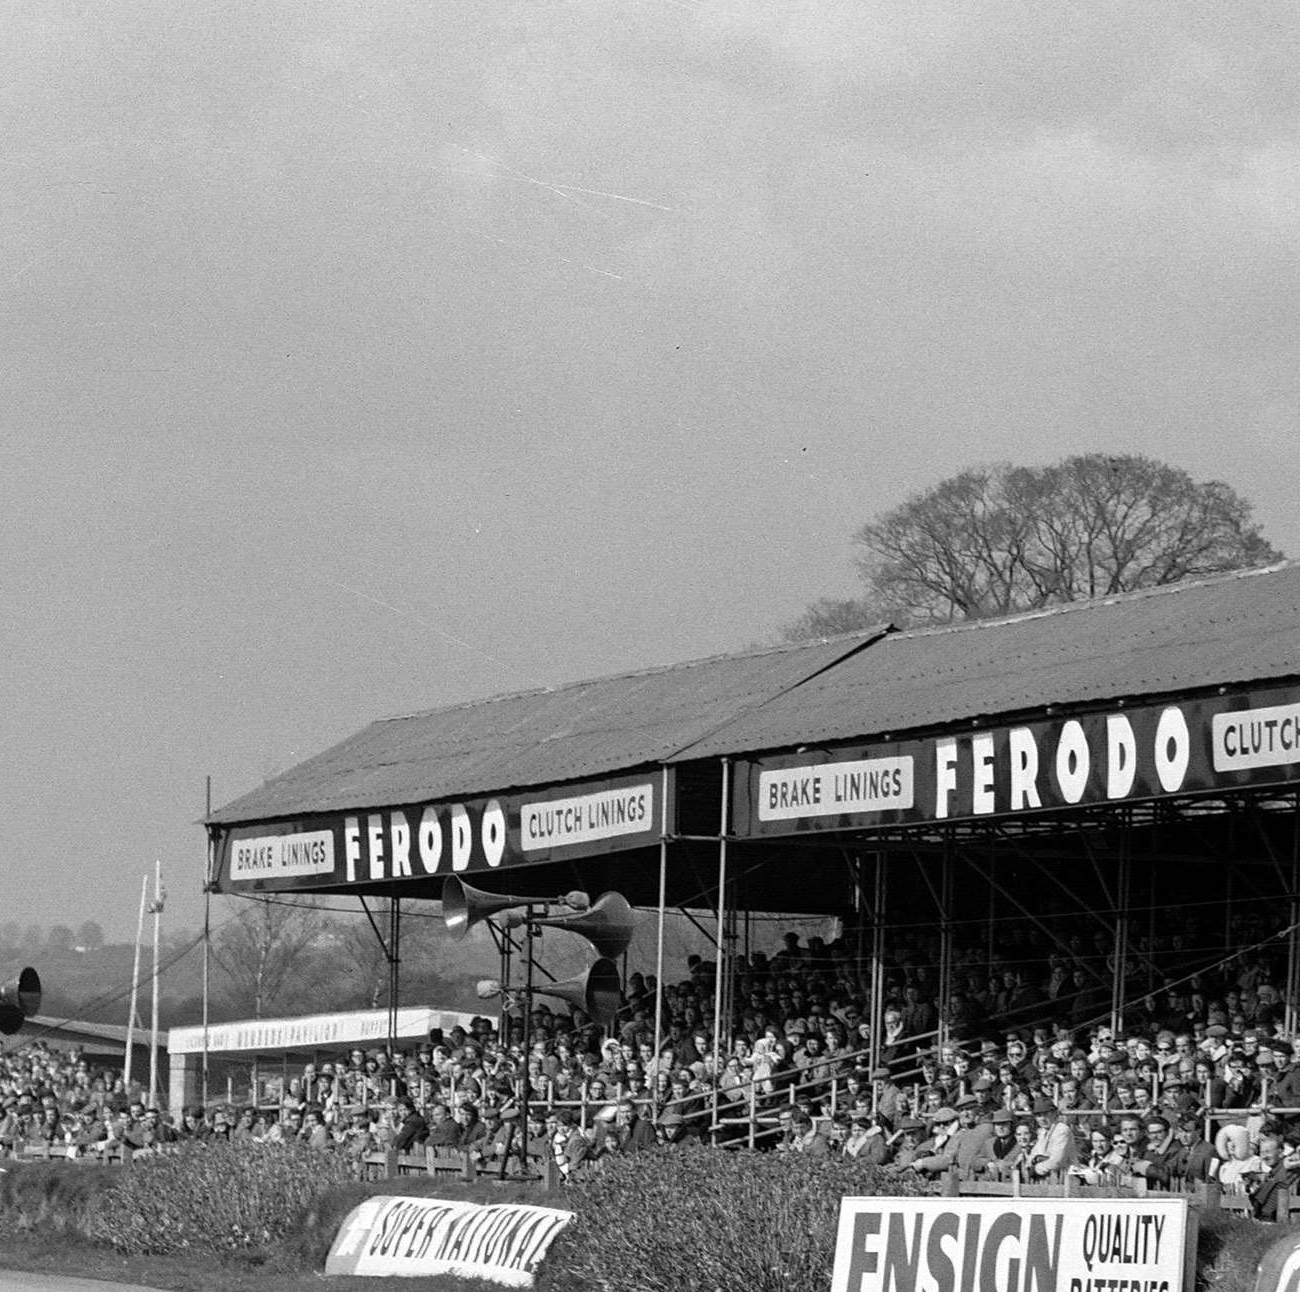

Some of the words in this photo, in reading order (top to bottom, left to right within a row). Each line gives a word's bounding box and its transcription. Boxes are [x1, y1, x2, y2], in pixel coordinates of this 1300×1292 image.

[769, 777, 821, 810] BRAKE
[834, 767, 902, 803] LININGS
[935, 706, 1191, 818] FERODO
[344, 800, 506, 882] FERODO
[529, 805, 582, 838] CLUTCH
[588, 795, 645, 829] LININGS
[238, 846, 273, 870] BRAKE
[281, 840, 326, 867] LININGS
[369, 1200, 454, 1259] SUPER
[435, 1207, 566, 1273] NATIONAL
[1083, 1213, 1166, 1272] QUALITY
